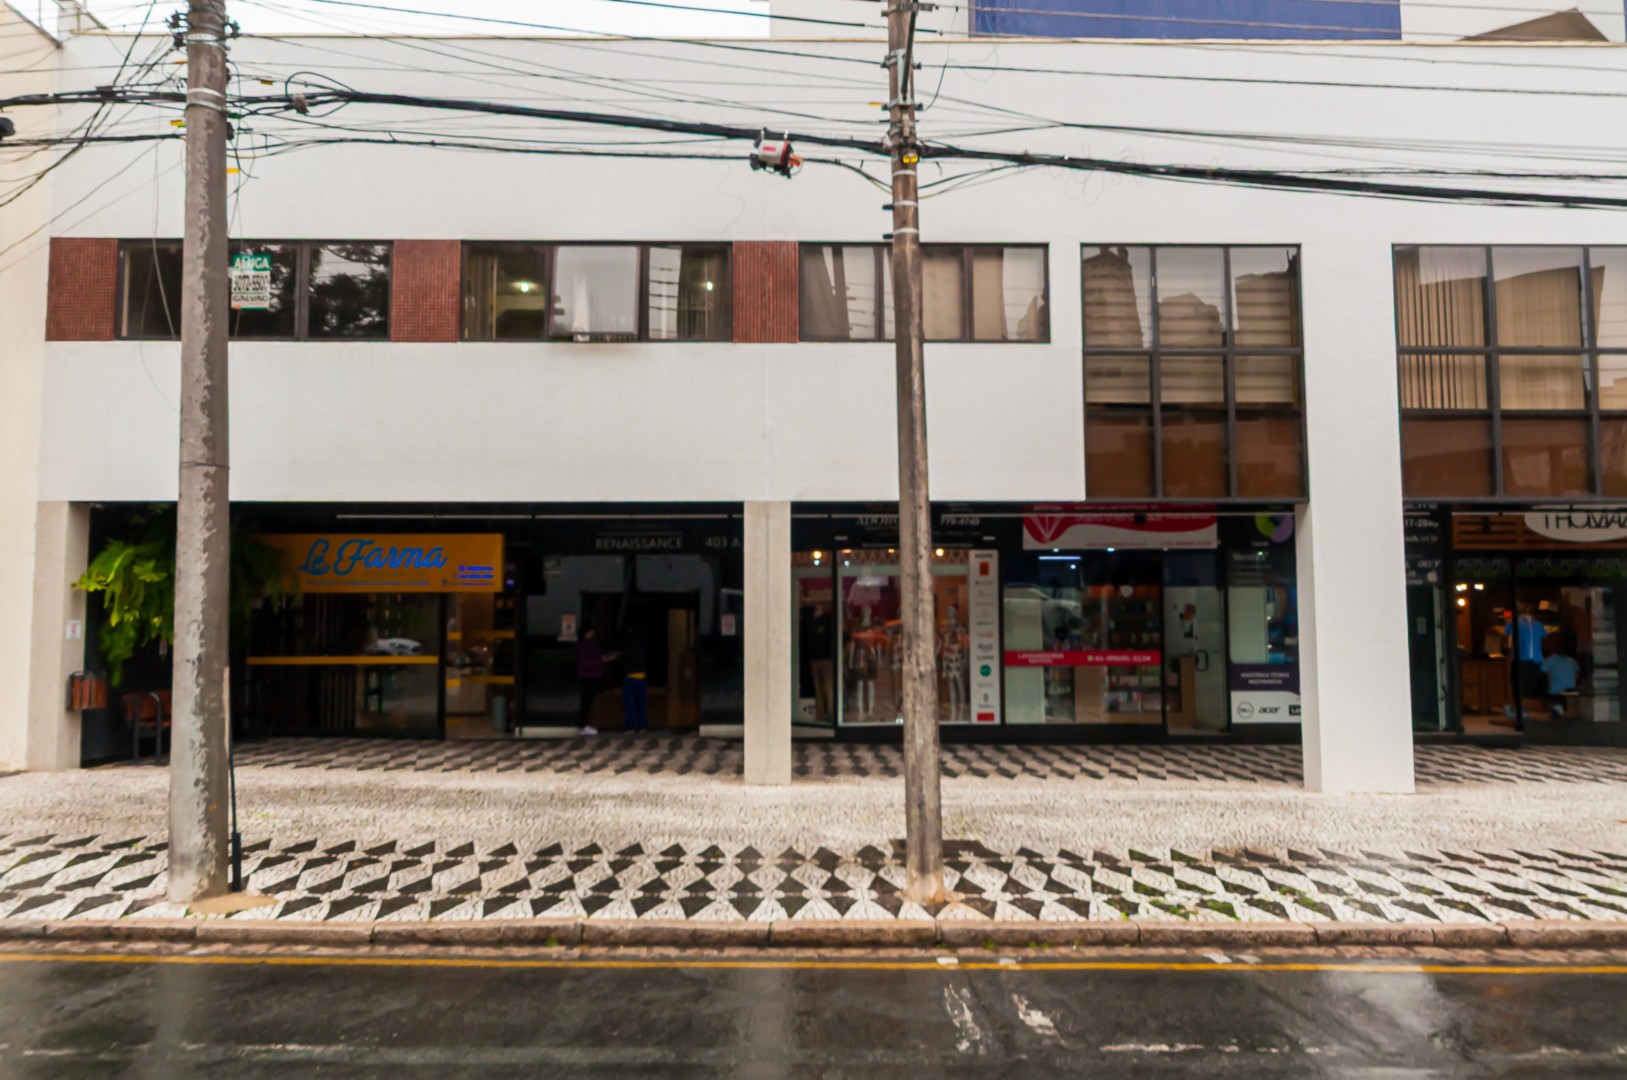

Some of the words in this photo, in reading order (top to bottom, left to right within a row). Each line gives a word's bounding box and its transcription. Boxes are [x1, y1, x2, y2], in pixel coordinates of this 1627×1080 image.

[595, 537, 684, 550] RENAISSANCE
[705, 537, 728, 548] 403
[731, 537, 741, 548] A
[297, 538, 330, 576] Le
[332, 538, 448, 576] Farma
[1258, 706, 1281, 714] acer
